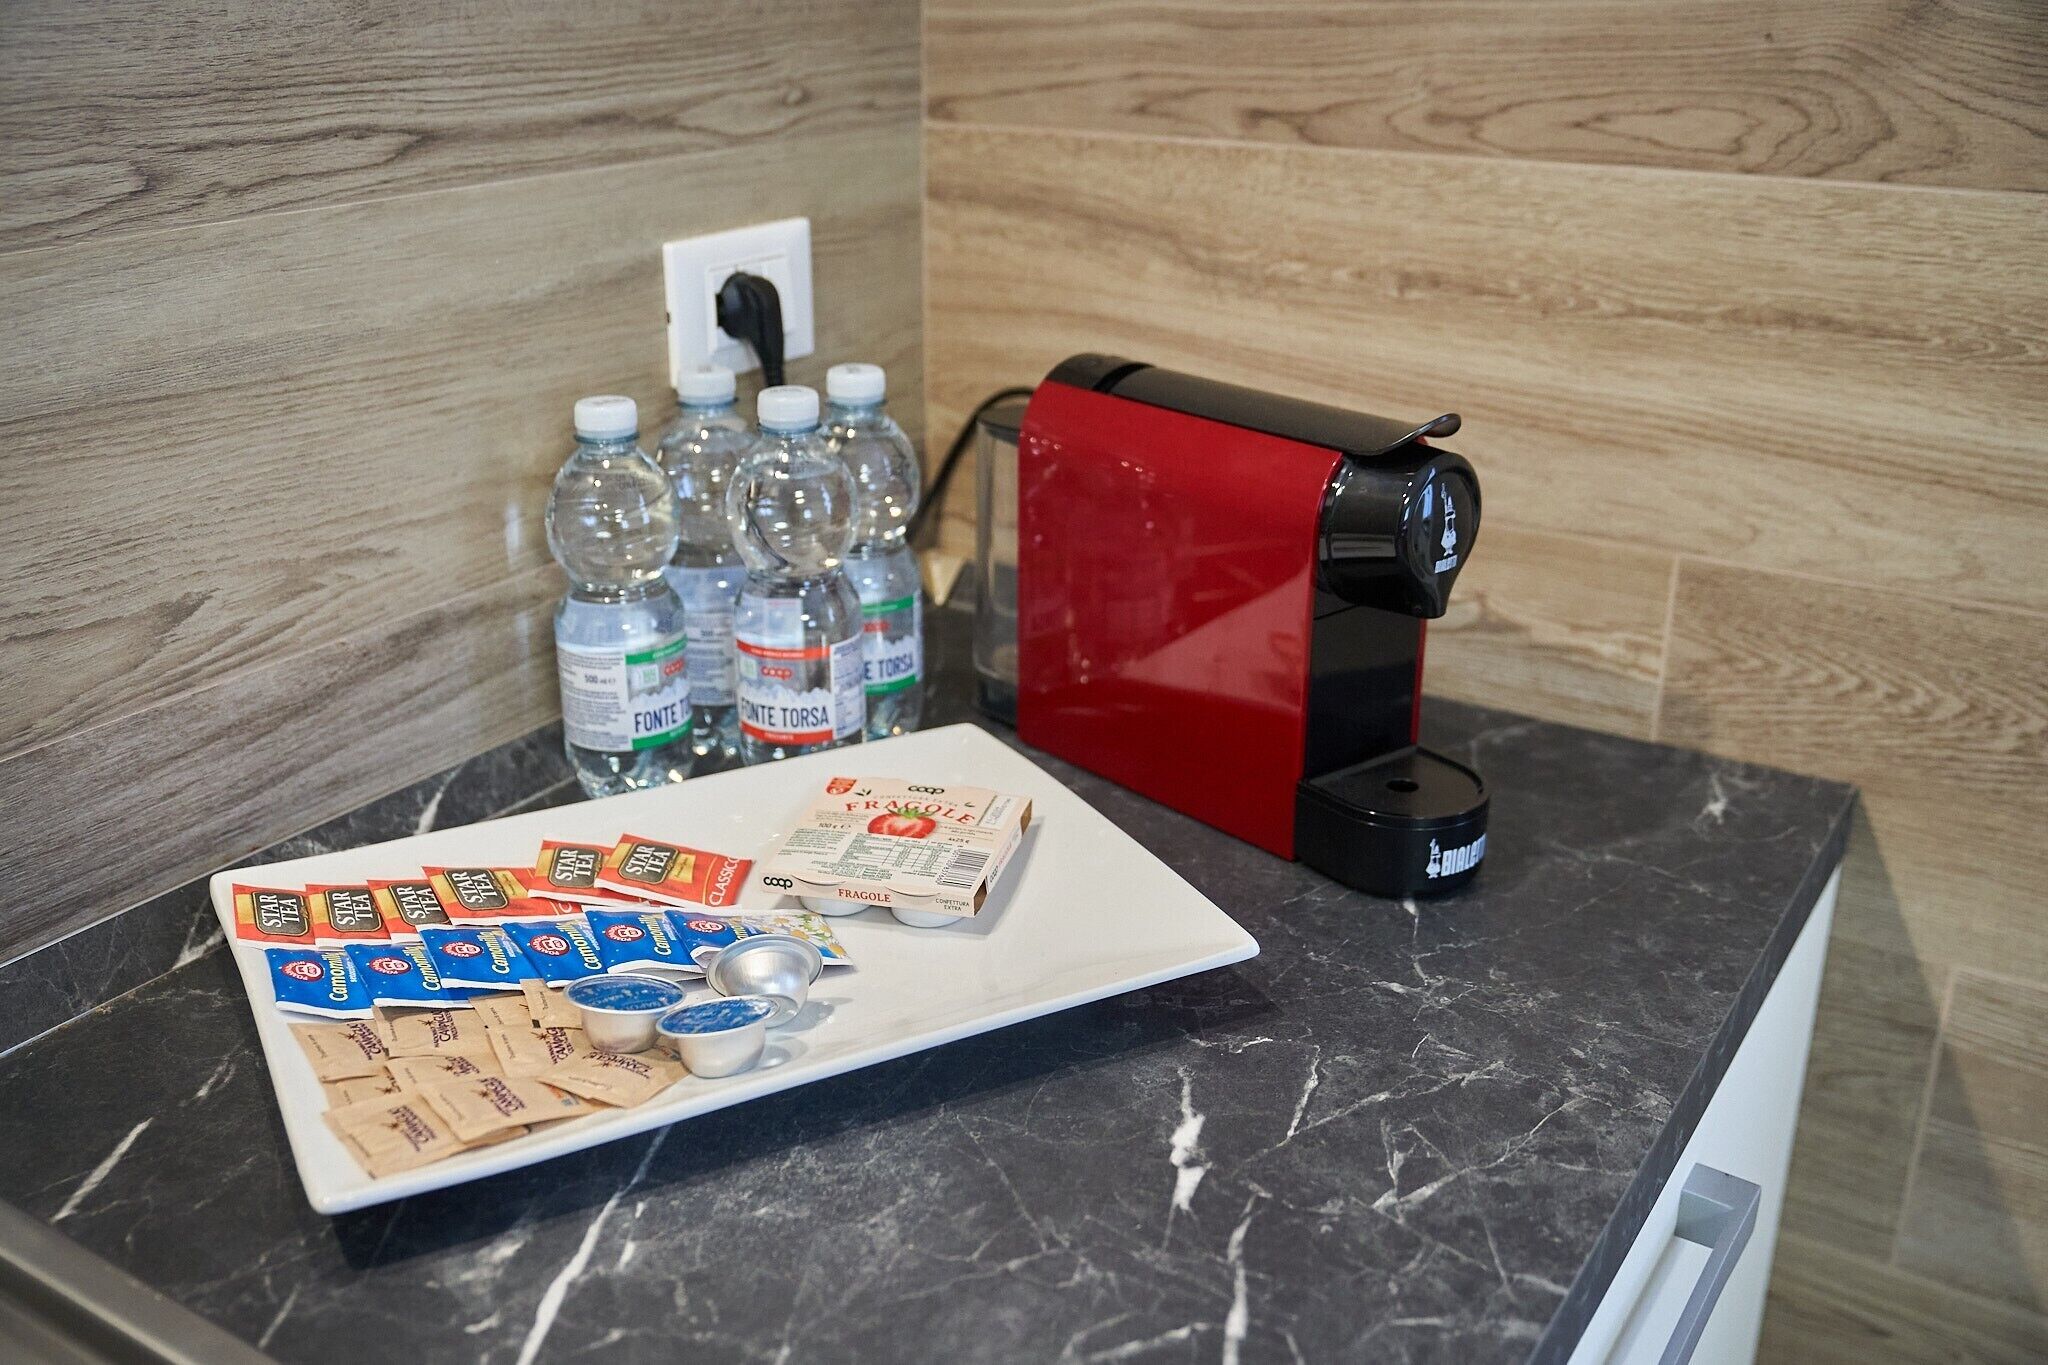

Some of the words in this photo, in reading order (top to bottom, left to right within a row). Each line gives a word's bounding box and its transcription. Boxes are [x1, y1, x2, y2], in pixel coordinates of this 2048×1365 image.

[634, 703, 677, 733] FONTE
[780, 706, 829, 728] TORSA
[908, 785, 945, 795] coop
[845, 800, 976, 825] FRAGOLE
[555, 850, 578, 880] STAR
[573, 854, 595, 877] TEA
[626, 846, 656, 875] STAR
[644, 851, 671, 873] TEA
[452, 871, 483, 903] STAR
[471, 873, 497, 899] TEA
[763, 876, 793, 890] coop
[838, 888, 892, 903] FRAGOLE
[259, 894, 282, 928] STAR
[279, 898, 300, 924] TEA
[332, 891, 356, 925] STAR
[352, 894, 373, 921] TEA
[396, 886, 426, 919] STAR
[416, 887, 441, 915] TEA
[935, 898, 970, 907] CONFETTURA
[944, 904, 962, 912] EXTRA
